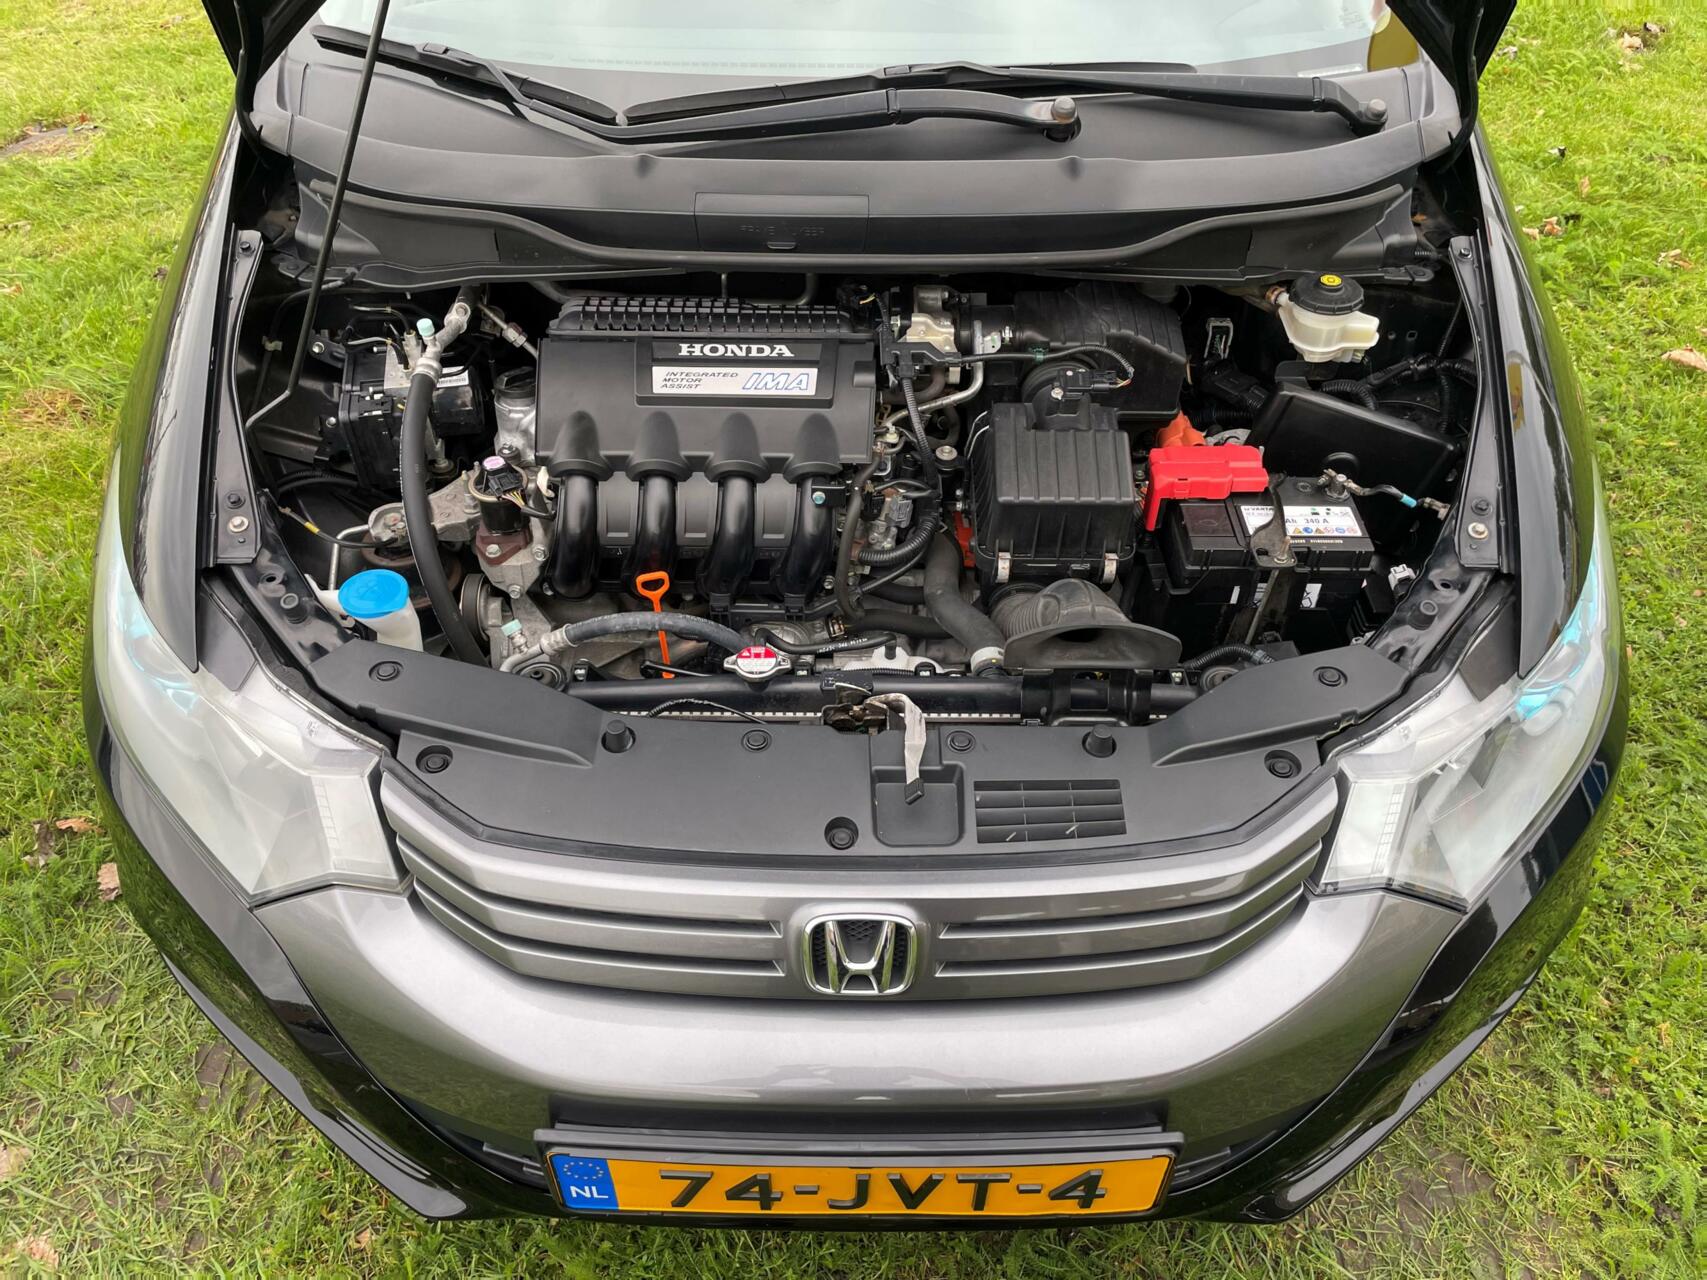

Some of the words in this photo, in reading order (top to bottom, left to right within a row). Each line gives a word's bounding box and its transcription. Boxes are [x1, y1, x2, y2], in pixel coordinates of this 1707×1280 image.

[678, 343, 795, 357] HONDA
[742, 372, 810, 391] IMA
[570, 1185, 609, 1199] NL
[659, 1169, 1107, 1211] 74-JVT-4
